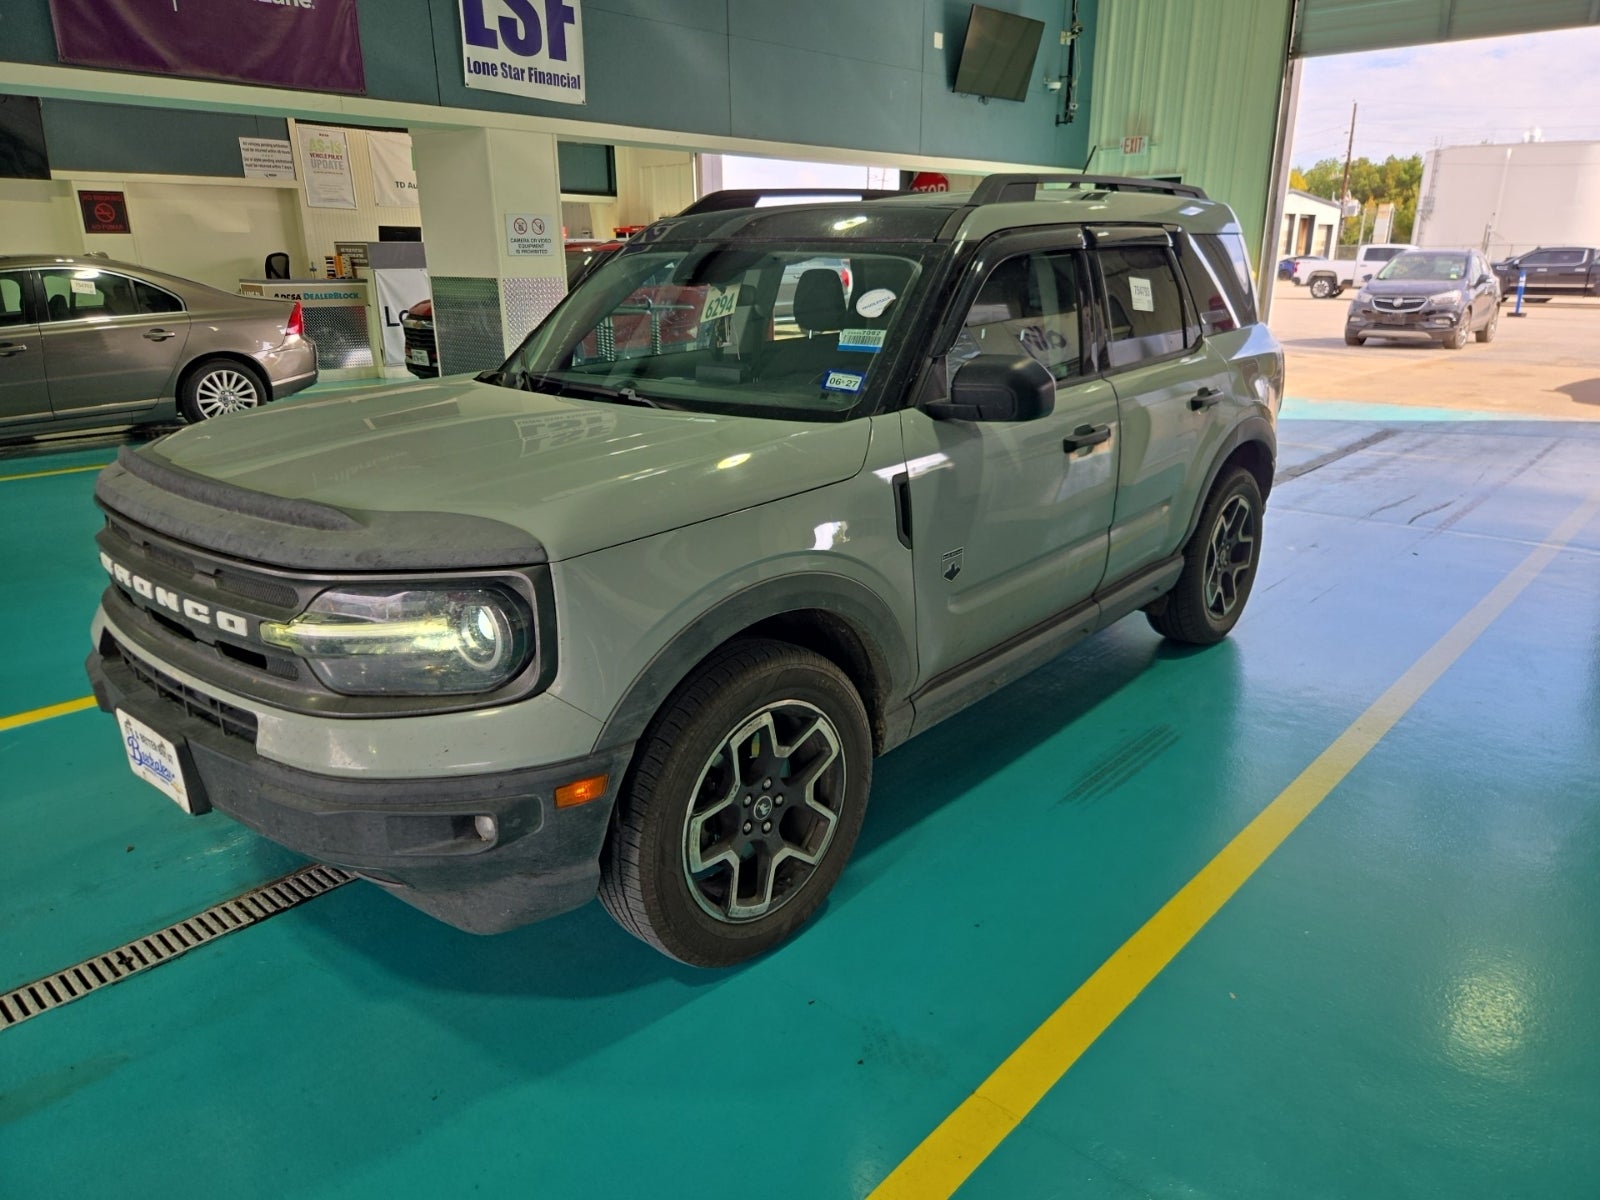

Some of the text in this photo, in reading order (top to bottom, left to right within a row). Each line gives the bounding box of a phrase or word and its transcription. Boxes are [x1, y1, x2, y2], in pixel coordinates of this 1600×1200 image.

[462, 0, 575, 61] LSF
[467, 57, 581, 90] Lone Star Financial
[309, 138, 342, 154] AS-IS
[1123, 137, 1143, 154] EXIT
[309, 152, 343, 161] VEHICLE POLICY
[311, 159, 344, 171] UPDATE
[395, 181, 406, 189] TD
[705, 292, 735, 319] 6294
[829, 377, 842, 386] 06
[845, 379, 859, 388] 27
[100, 551, 248, 637] BRONCO
